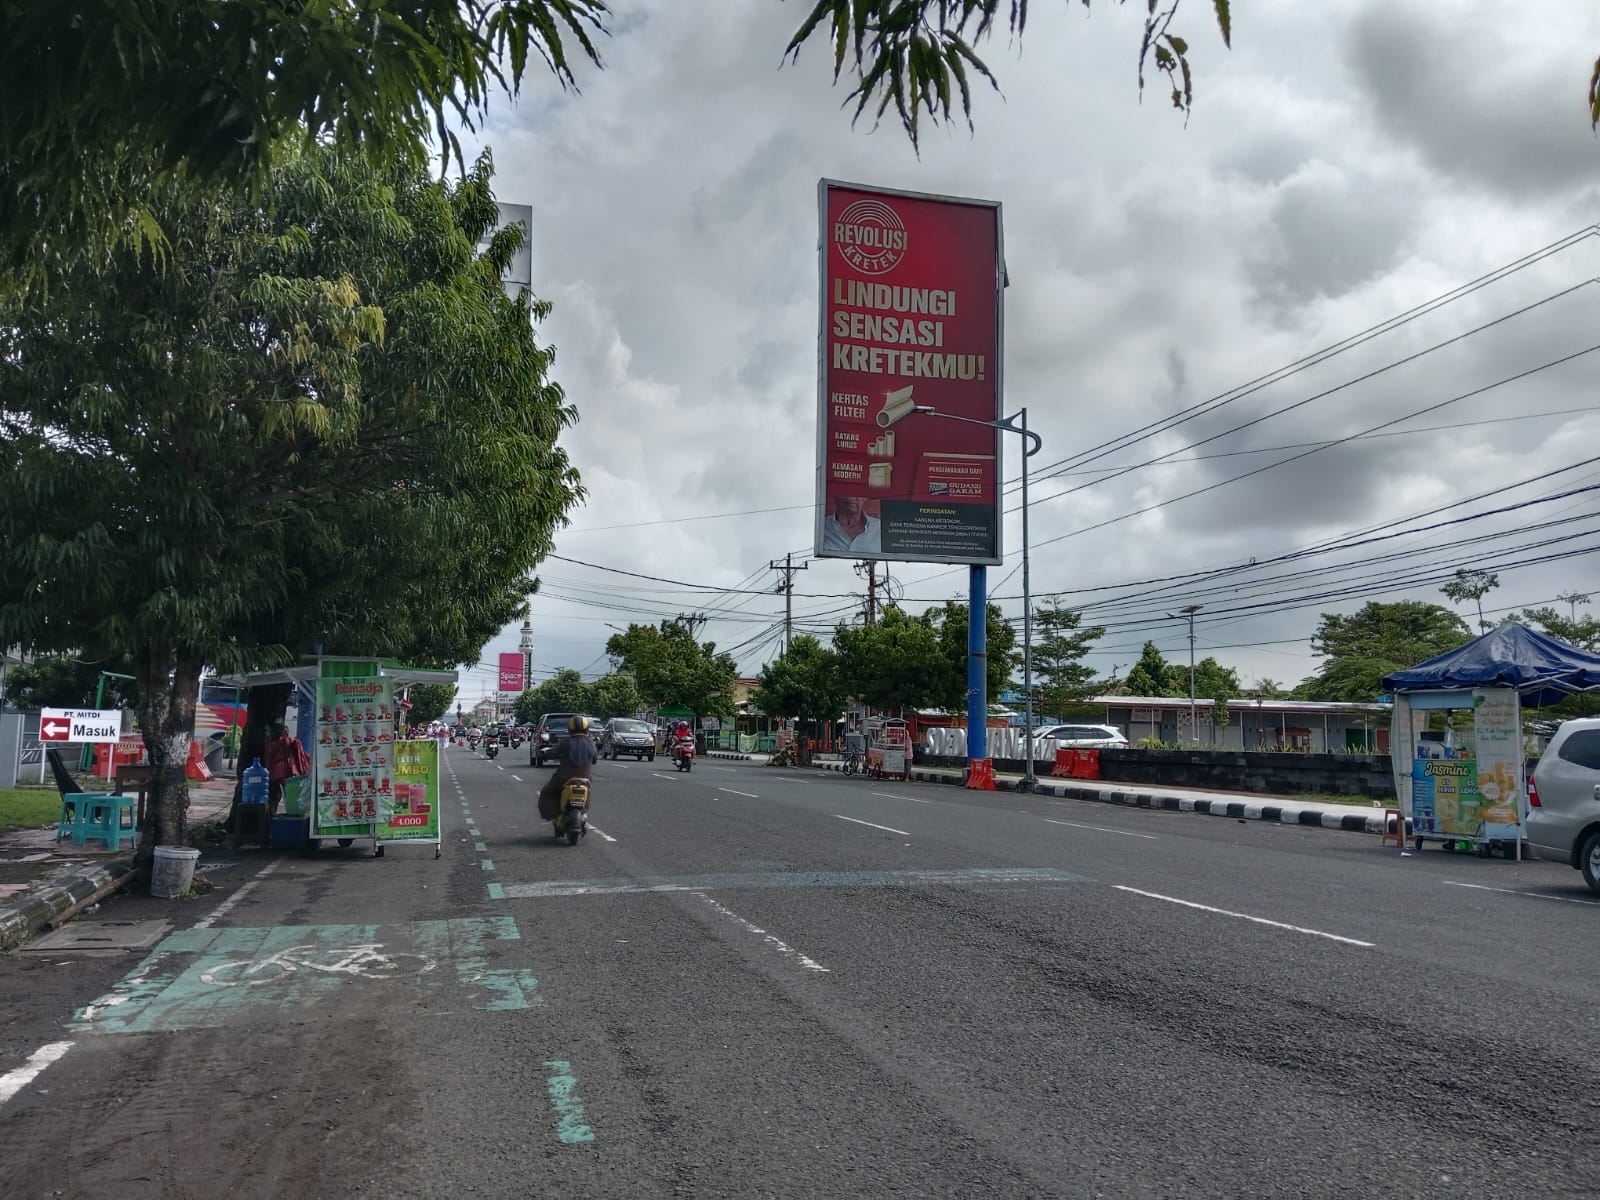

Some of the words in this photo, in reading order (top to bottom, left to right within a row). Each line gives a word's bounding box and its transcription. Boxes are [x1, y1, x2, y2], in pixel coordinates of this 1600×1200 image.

[834, 222, 908, 251] REVOLUSI
[844, 245, 897, 271] KRETEK
[834, 278, 956, 317] LINDUNGI
[833, 311, 944, 347] SENSASI
[833, 343, 986, 381] KRETEKMU!
[831, 392, 869, 406] KERTAS
[834, 405, 866, 419] FILTER
[835, 431, 860, 441] BATANG
[837, 440, 858, 449] LURUS
[832, 462, 863, 472] KEMASAN
[833, 470, 862, 480] MODERN
[500, 672, 521, 681] Space
[73, 724, 116, 737] Masuk
[394, 764, 429, 775] UMBO
[1424, 761, 1470, 777] Jasmine
